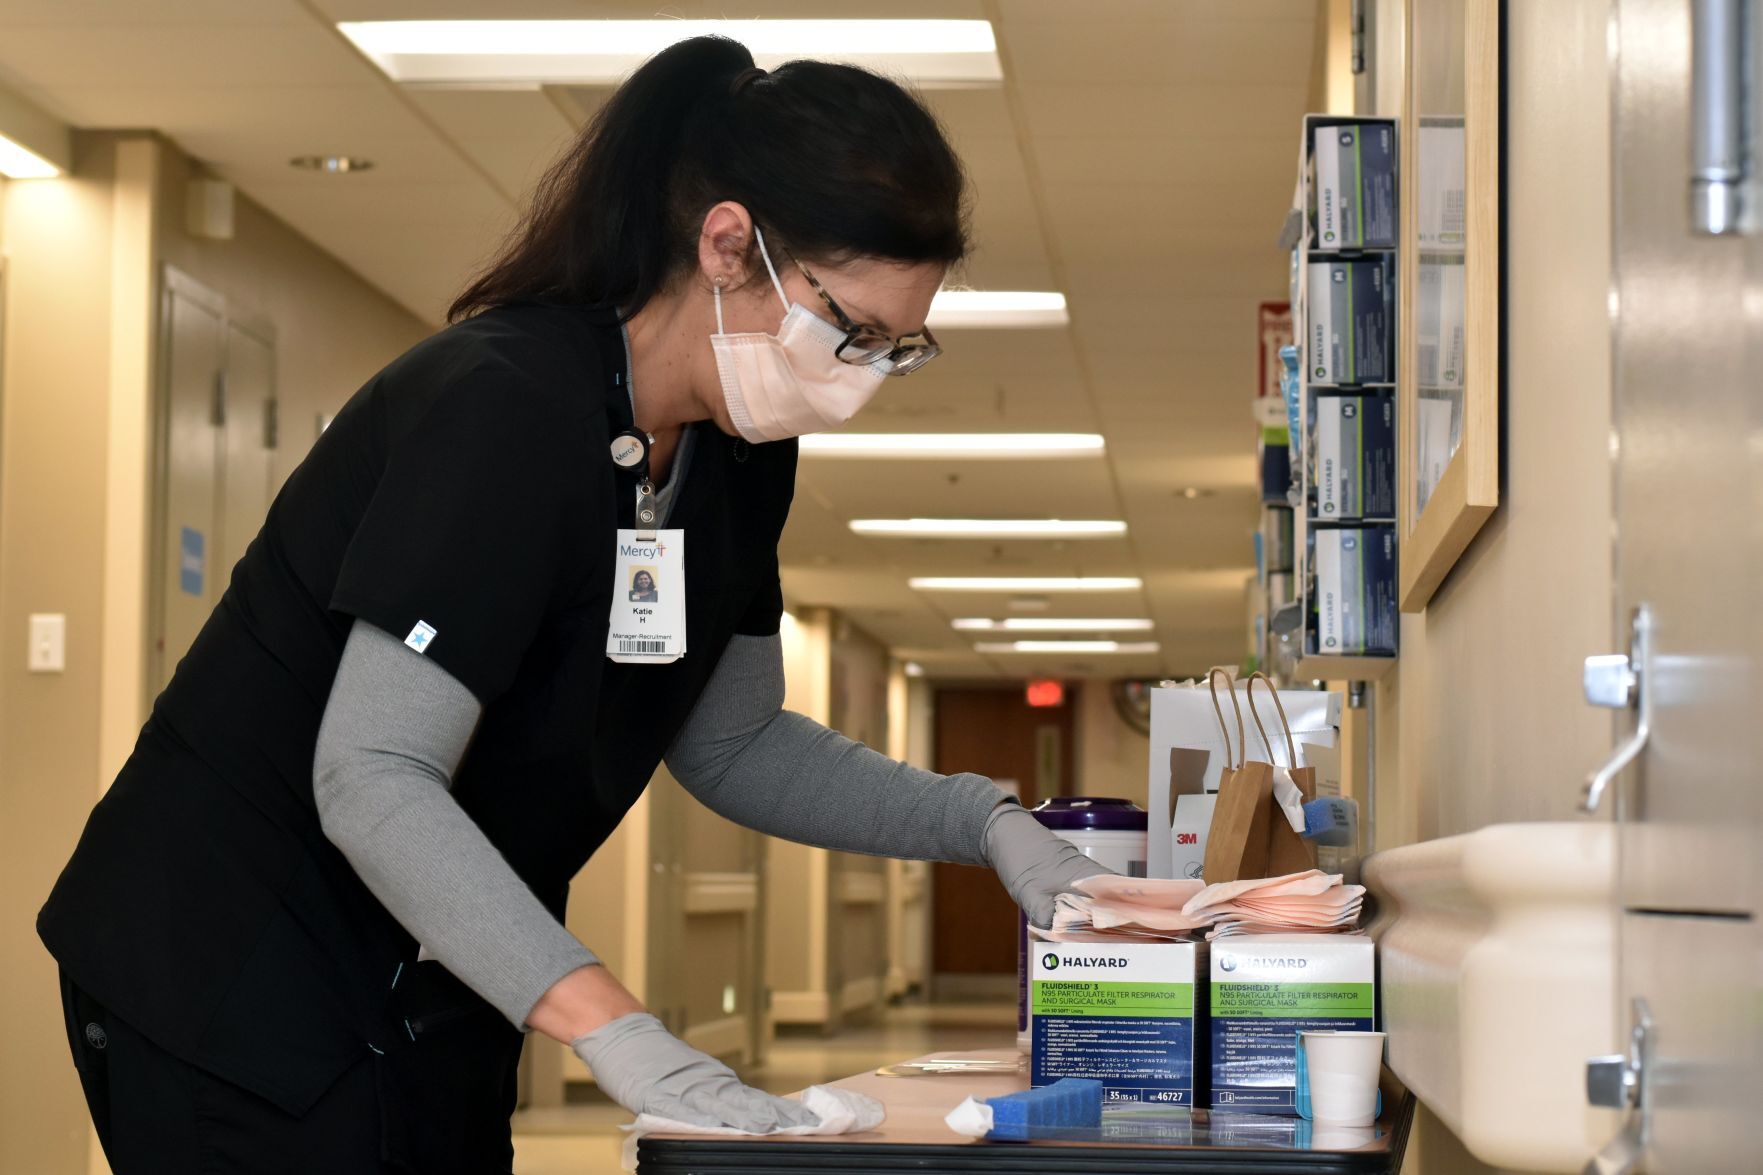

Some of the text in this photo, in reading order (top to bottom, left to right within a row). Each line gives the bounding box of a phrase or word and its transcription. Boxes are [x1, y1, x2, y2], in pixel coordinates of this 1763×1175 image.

[1324, 188, 1332, 229] HALYARD
[1335, 271, 1344, 281] M
[1316, 324, 1324, 365] HALYARD
[1344, 407, 1353, 416] M
[615, 446, 635, 462] Mercy
[1325, 459, 1333, 500] HALYARD
[1344, 540, 1354, 548] L
[620, 545, 656, 559] Mercy
[633, 607, 653, 616] Katie
[1326, 592, 1334, 634] HALYARD
[613, 633, 672, 641] Manager-Recruitment
[1177, 833, 1197, 844] 3M
[1063, 957, 1128, 968] HALYARD
[1110, 1090, 1120, 1100] 35
[1157, 1091, 1183, 1102] 46727
